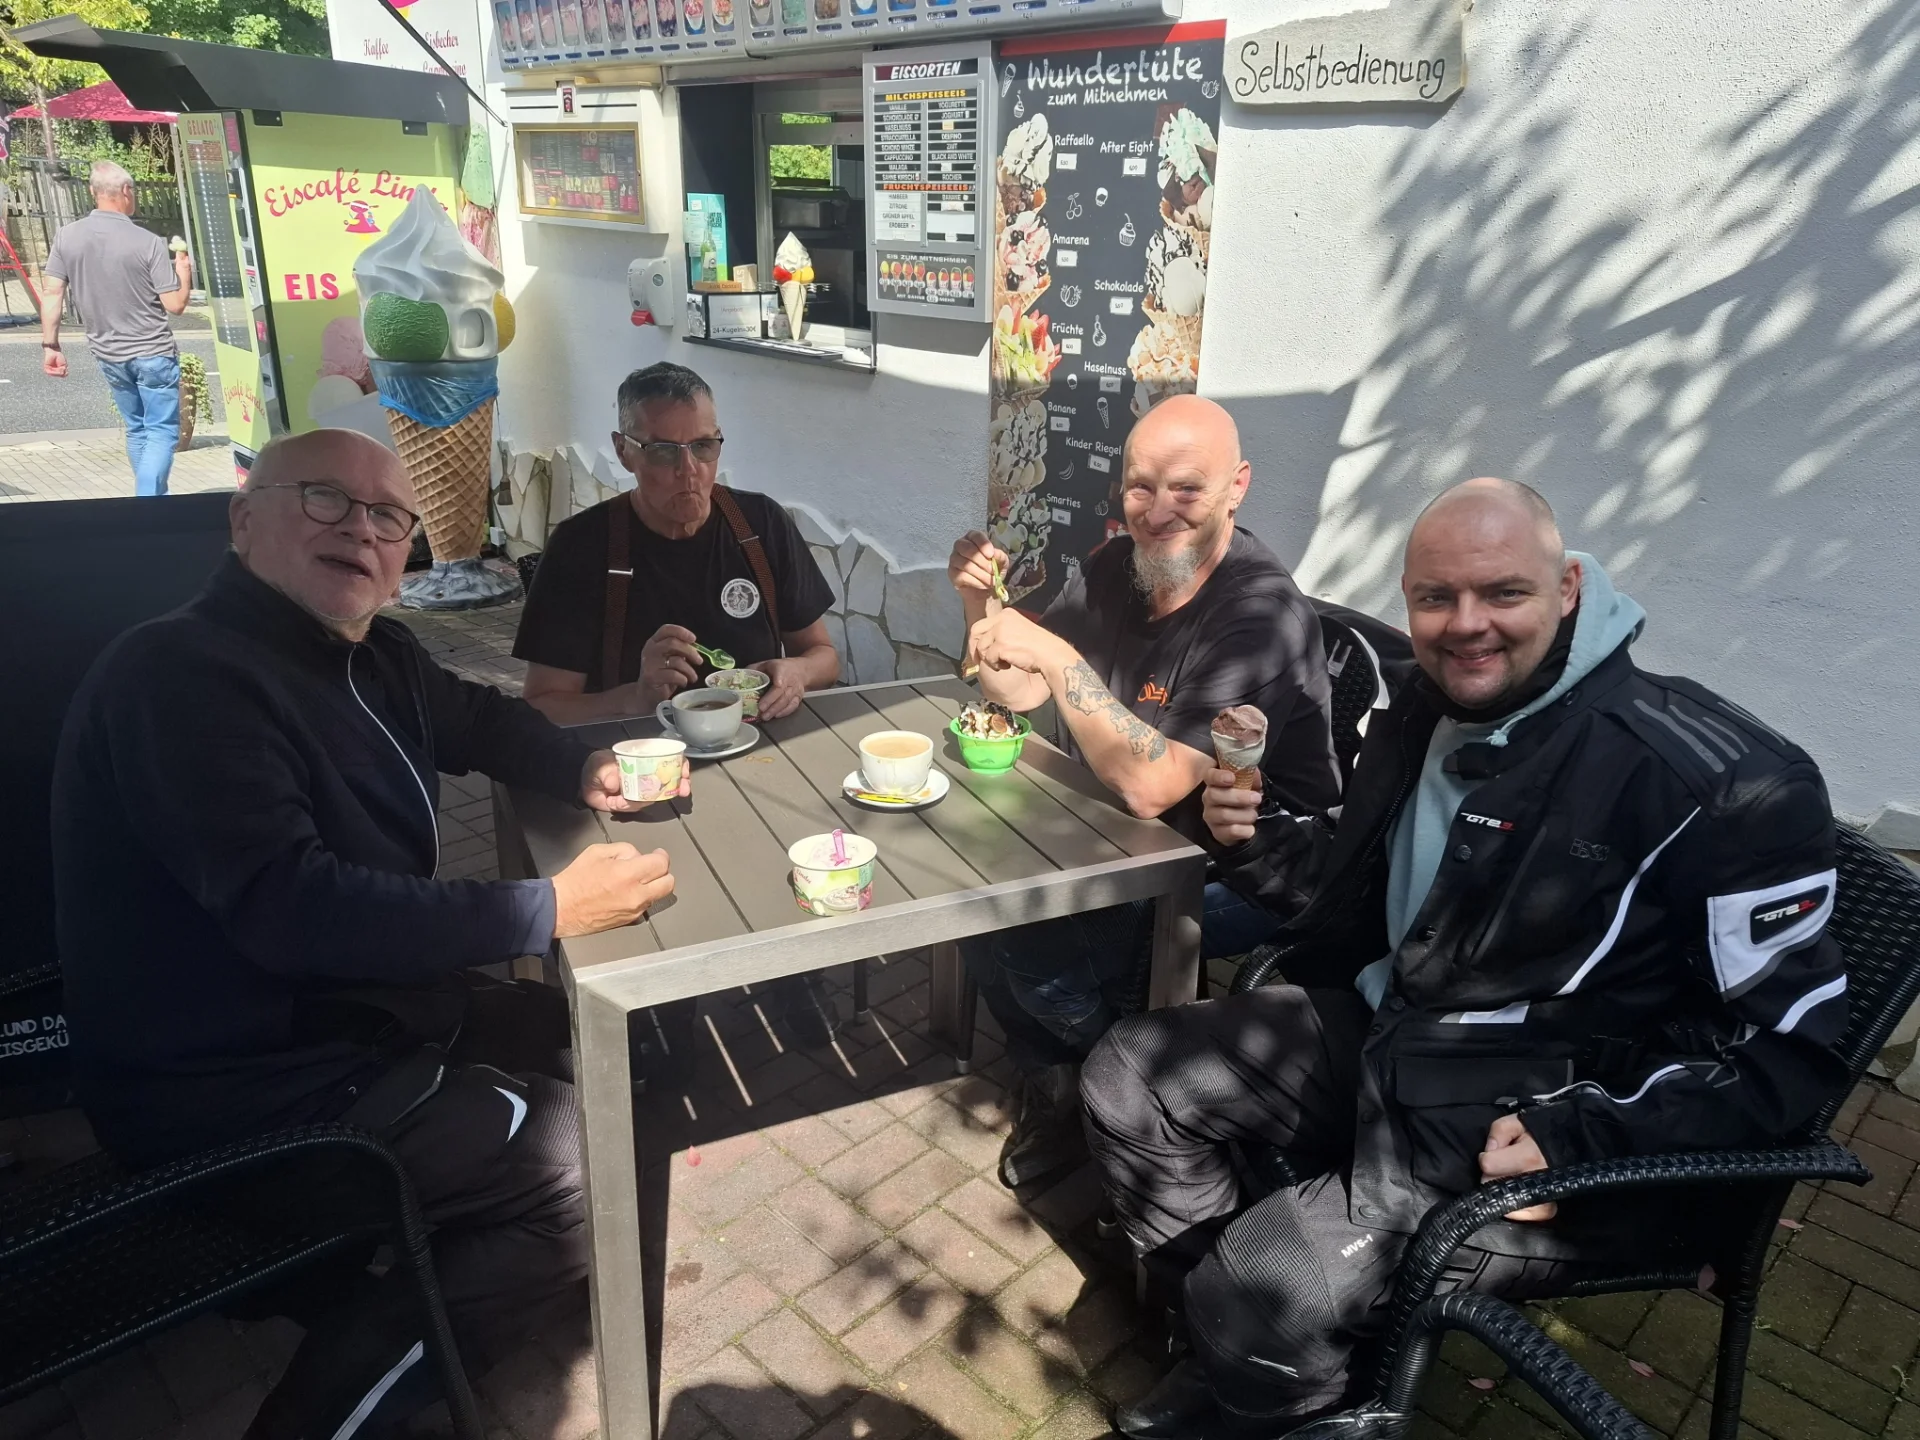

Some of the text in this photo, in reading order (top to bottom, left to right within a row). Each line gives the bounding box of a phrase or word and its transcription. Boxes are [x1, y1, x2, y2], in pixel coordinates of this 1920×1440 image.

[363, 37, 389, 60] Kaffee
[890, 61, 961, 80] EISSORTEN
[1027, 46, 1204, 91] Wundertüte
[1235, 40, 1446, 99] Selbstbedienung
[885, 89, 966, 102] MILCHSPEISEEIS
[1047, 86, 1168, 106] zum Mitnehmen
[187, 119, 215, 136] GELATO
[1055, 134, 1094, 147] Raffaello
[1100, 140, 1154, 156] After Eight
[264, 167, 448, 217] Eiscafé Lin
[1052, 233, 1090, 246] Amarena
[919, 255, 967, 264] MITNEHMEN
[284, 273, 340, 301] EIS
[1094, 279, 1144, 294] Schokolade
[1051, 322, 1084, 336] Früchte
[1084, 361, 1127, 376] Haselnuss
[1047, 401, 1077, 415] Banane
[1065, 437, 1122, 457] Kinder Riegel
[1046, 492, 1081, 509] Smarties
[0, 1029, 70, 1058] ISGEKÜ
[1341, 1233, 1374, 1258] MVS-1
